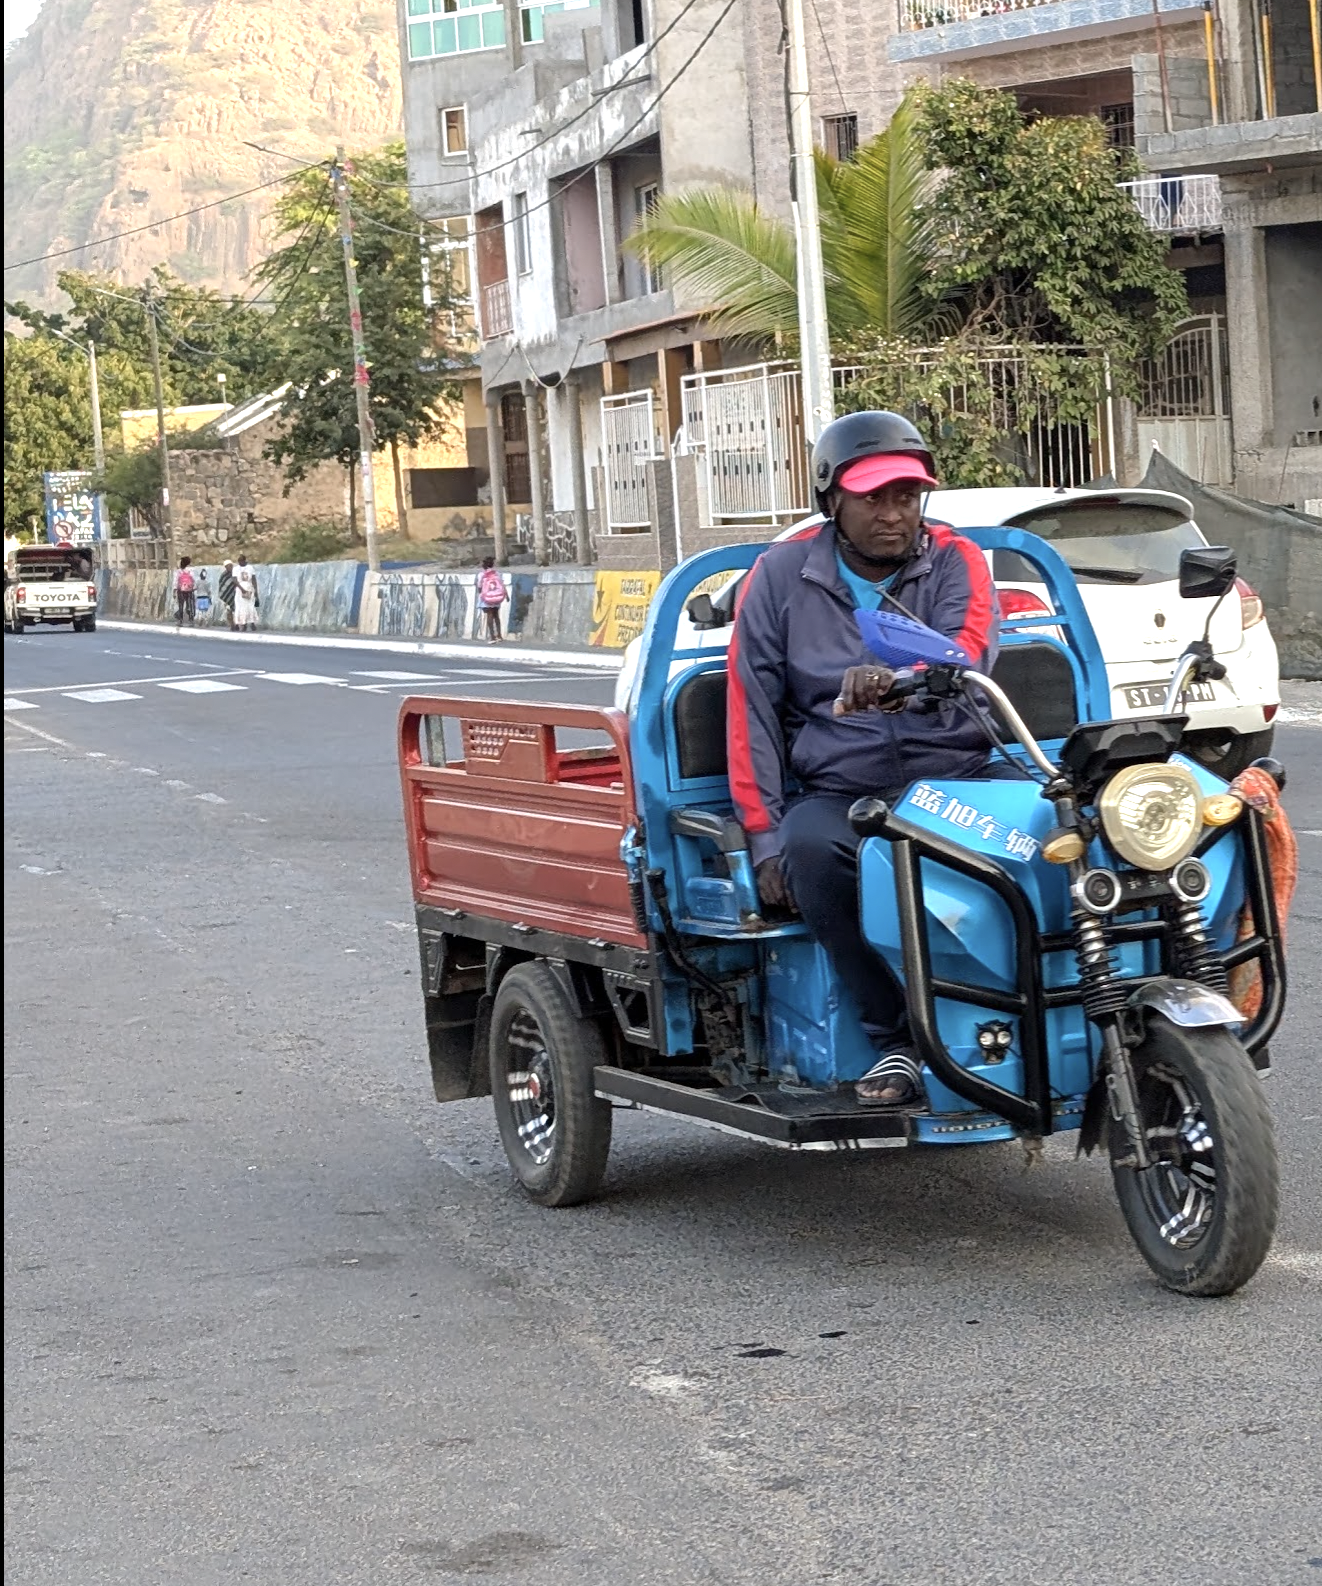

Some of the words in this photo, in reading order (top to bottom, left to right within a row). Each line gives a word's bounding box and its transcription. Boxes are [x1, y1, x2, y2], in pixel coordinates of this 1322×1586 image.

[34, 594, 80, 602] TOYOTA
[1130, 683, 1213, 707] ST--PN
[908, 783, 1041, 861] 蓝旭车辆
